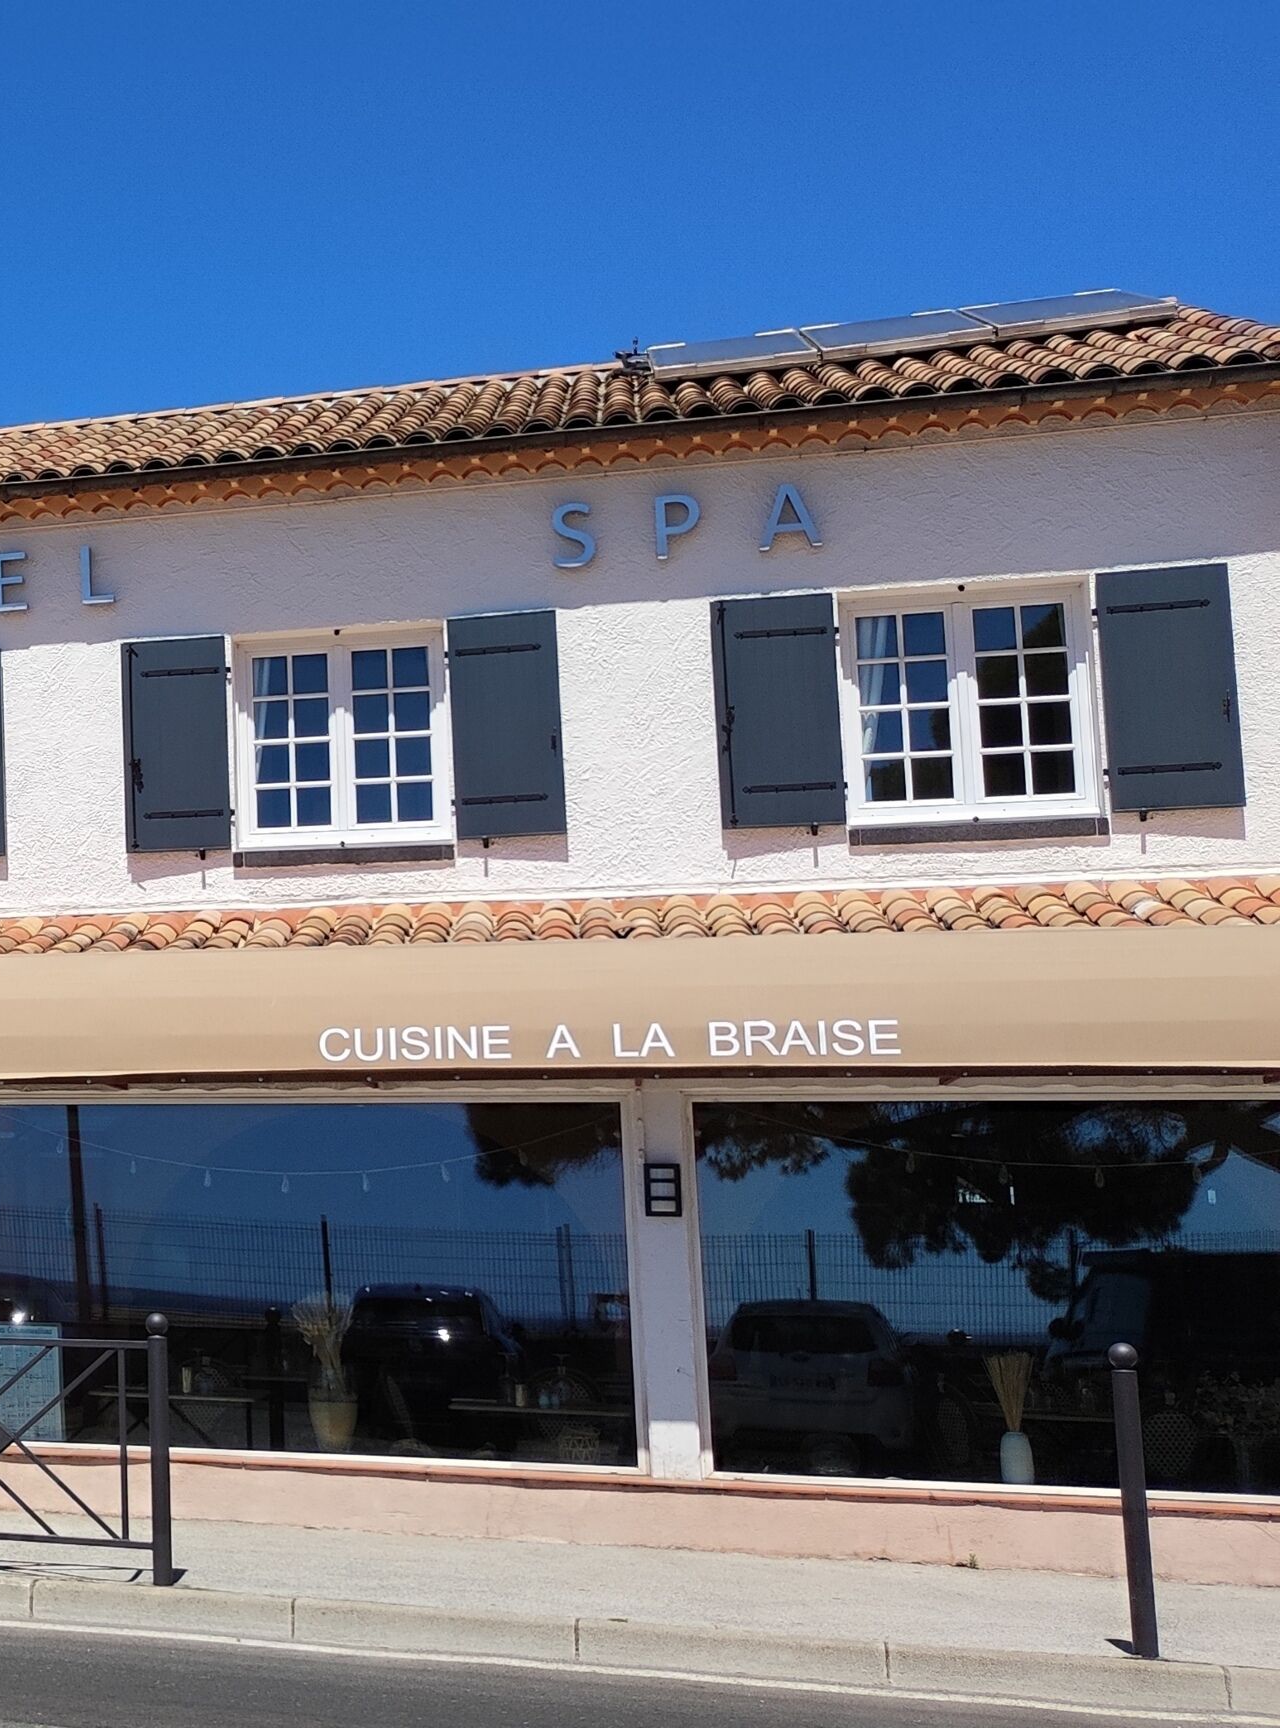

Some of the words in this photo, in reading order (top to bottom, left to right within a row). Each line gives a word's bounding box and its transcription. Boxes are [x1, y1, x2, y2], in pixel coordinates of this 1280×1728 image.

[551, 483, 823, 568] SPA
[318, 1024, 514, 1062] CUISINE
[545, 1024, 581, 1059] A
[612, 1022, 676, 1058] LA
[707, 1018, 903, 1057] BRAISE
